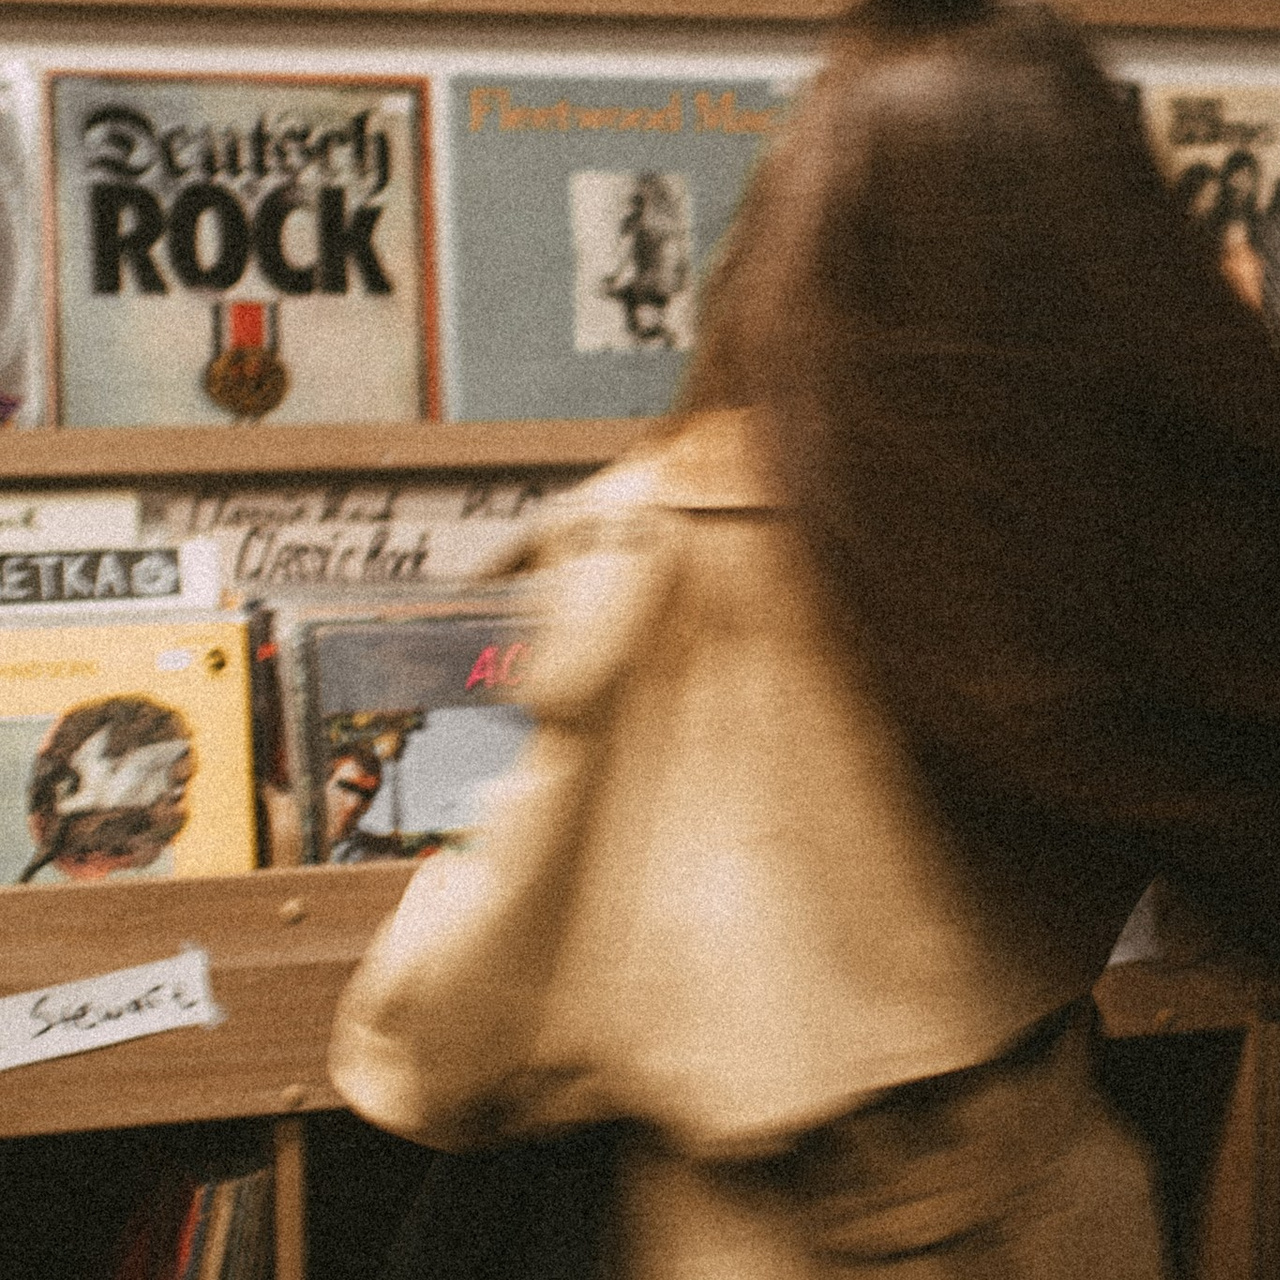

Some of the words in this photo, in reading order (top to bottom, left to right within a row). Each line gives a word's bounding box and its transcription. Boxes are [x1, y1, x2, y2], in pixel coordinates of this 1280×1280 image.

[468, 86, 682, 134] Fleetwood
[81, 102, 392, 196] Deutsch
[89, 182, 394, 295] ROCK
[0, 553, 130, 601] ETKA
